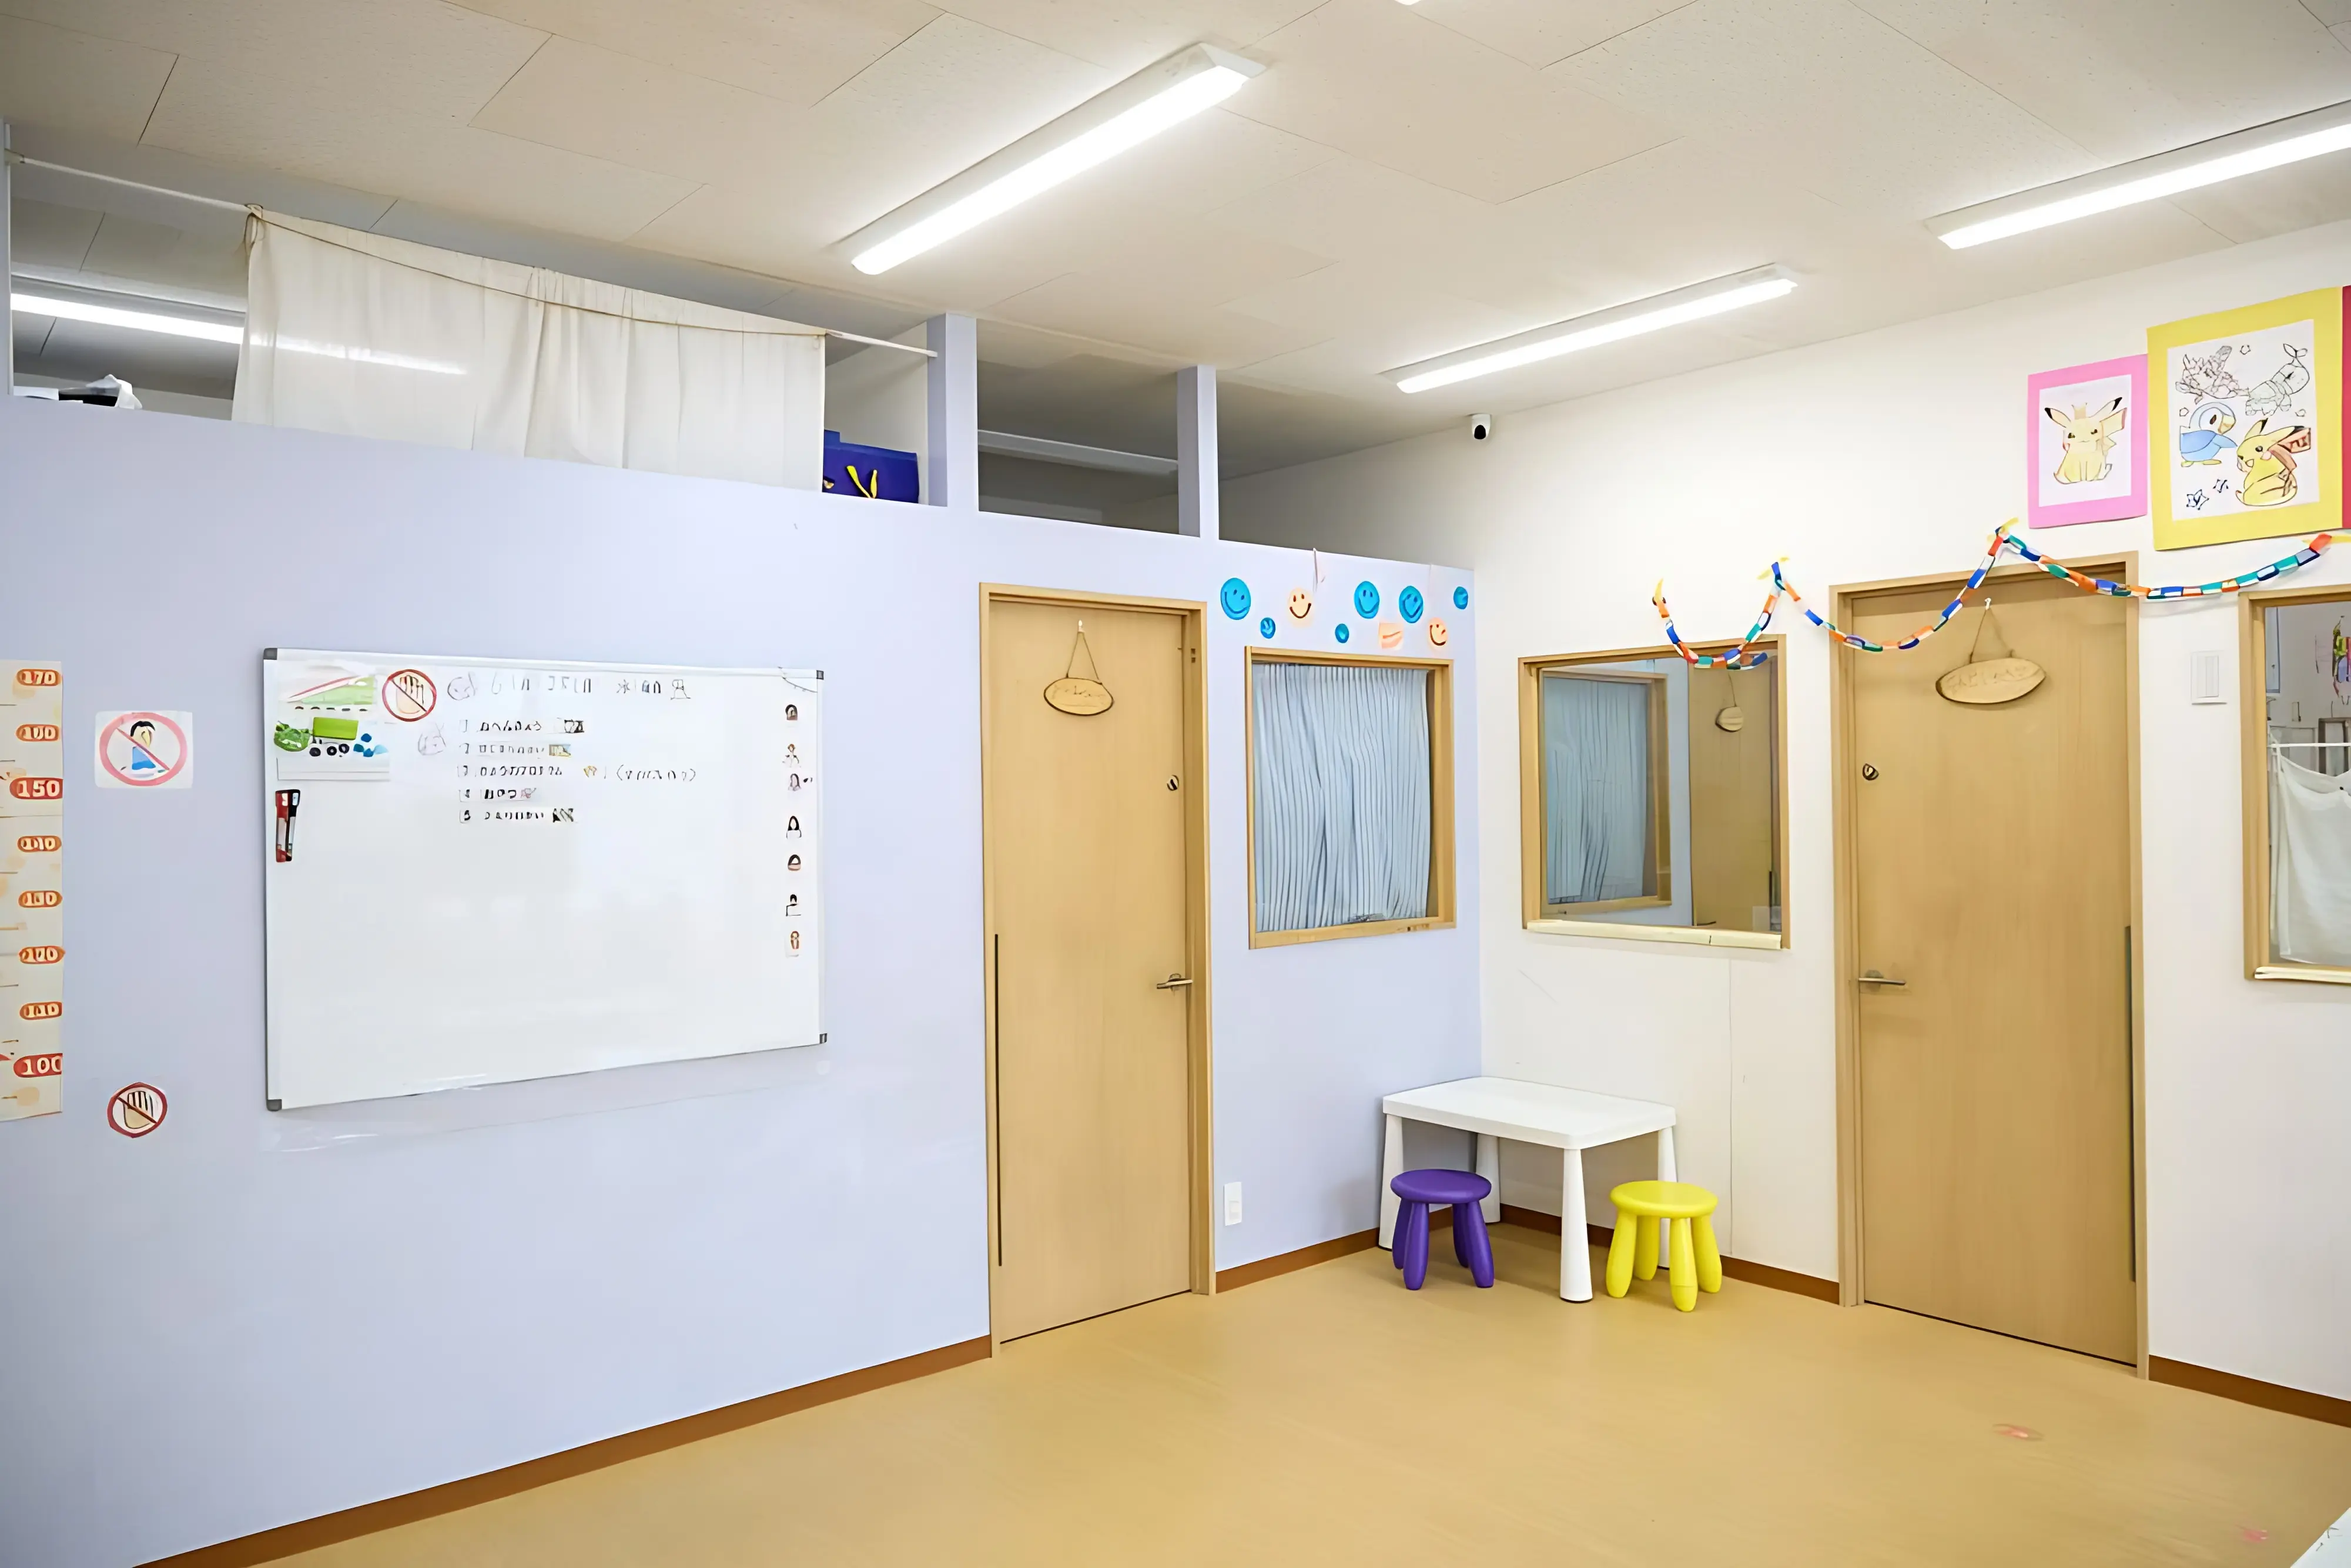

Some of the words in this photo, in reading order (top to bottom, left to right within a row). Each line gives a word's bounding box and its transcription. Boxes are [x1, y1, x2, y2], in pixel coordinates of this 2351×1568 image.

[22, 671, 56, 685] 170
[17, 780, 61, 798] 150
[22, 1055, 62, 1076] 100
